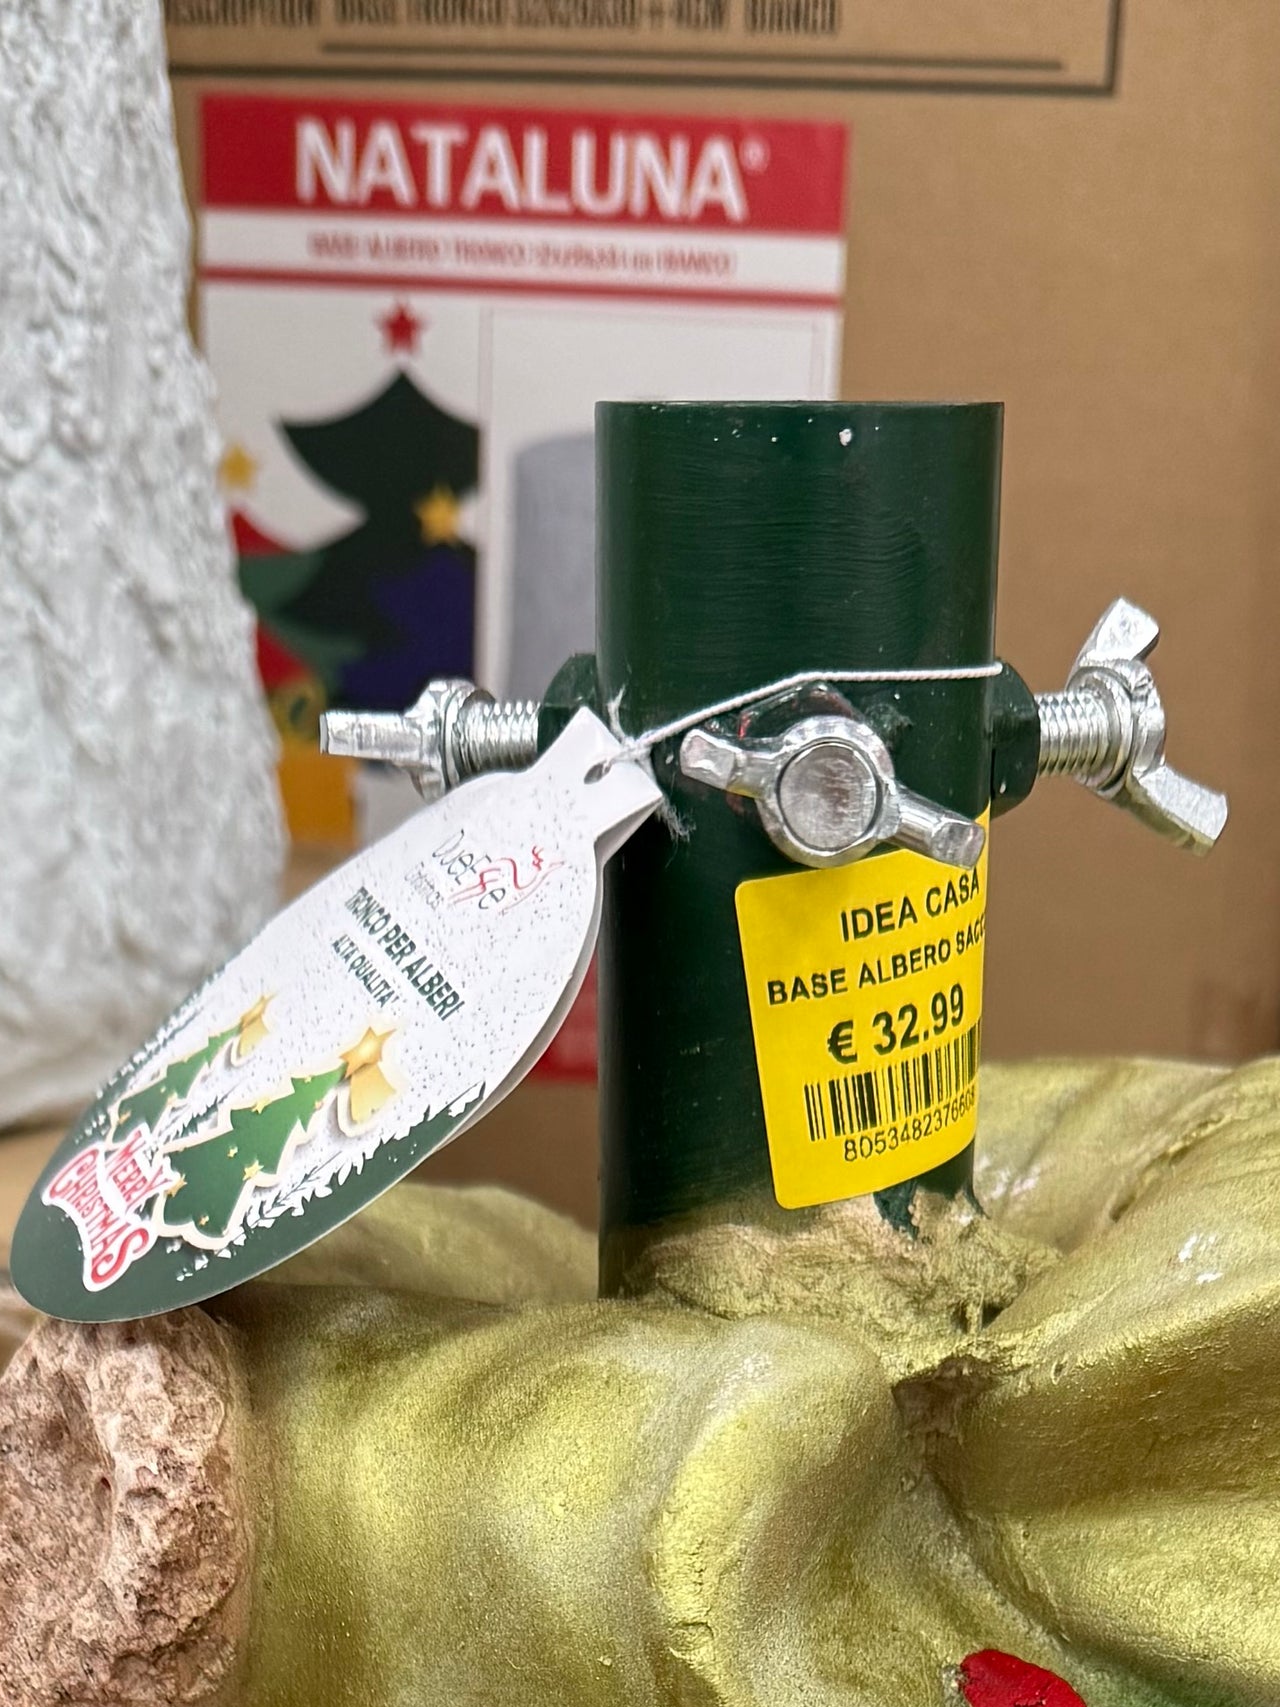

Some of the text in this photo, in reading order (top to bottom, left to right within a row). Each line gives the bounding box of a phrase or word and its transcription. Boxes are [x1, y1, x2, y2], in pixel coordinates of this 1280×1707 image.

[841, 868, 980, 942] IDEA CASA
[332, 934, 360, 964] ALTA
[345, 886, 465, 1021] TRONCO PER ALBERI
[768, 967, 849, 1006] BASE
[859, 937, 951, 989] ALBERO
[827, 982, 964, 1064] € 32.99
[105, 1130, 172, 1214] MERRY
[49, 1148, 150, 1284] CHRISTMAS
